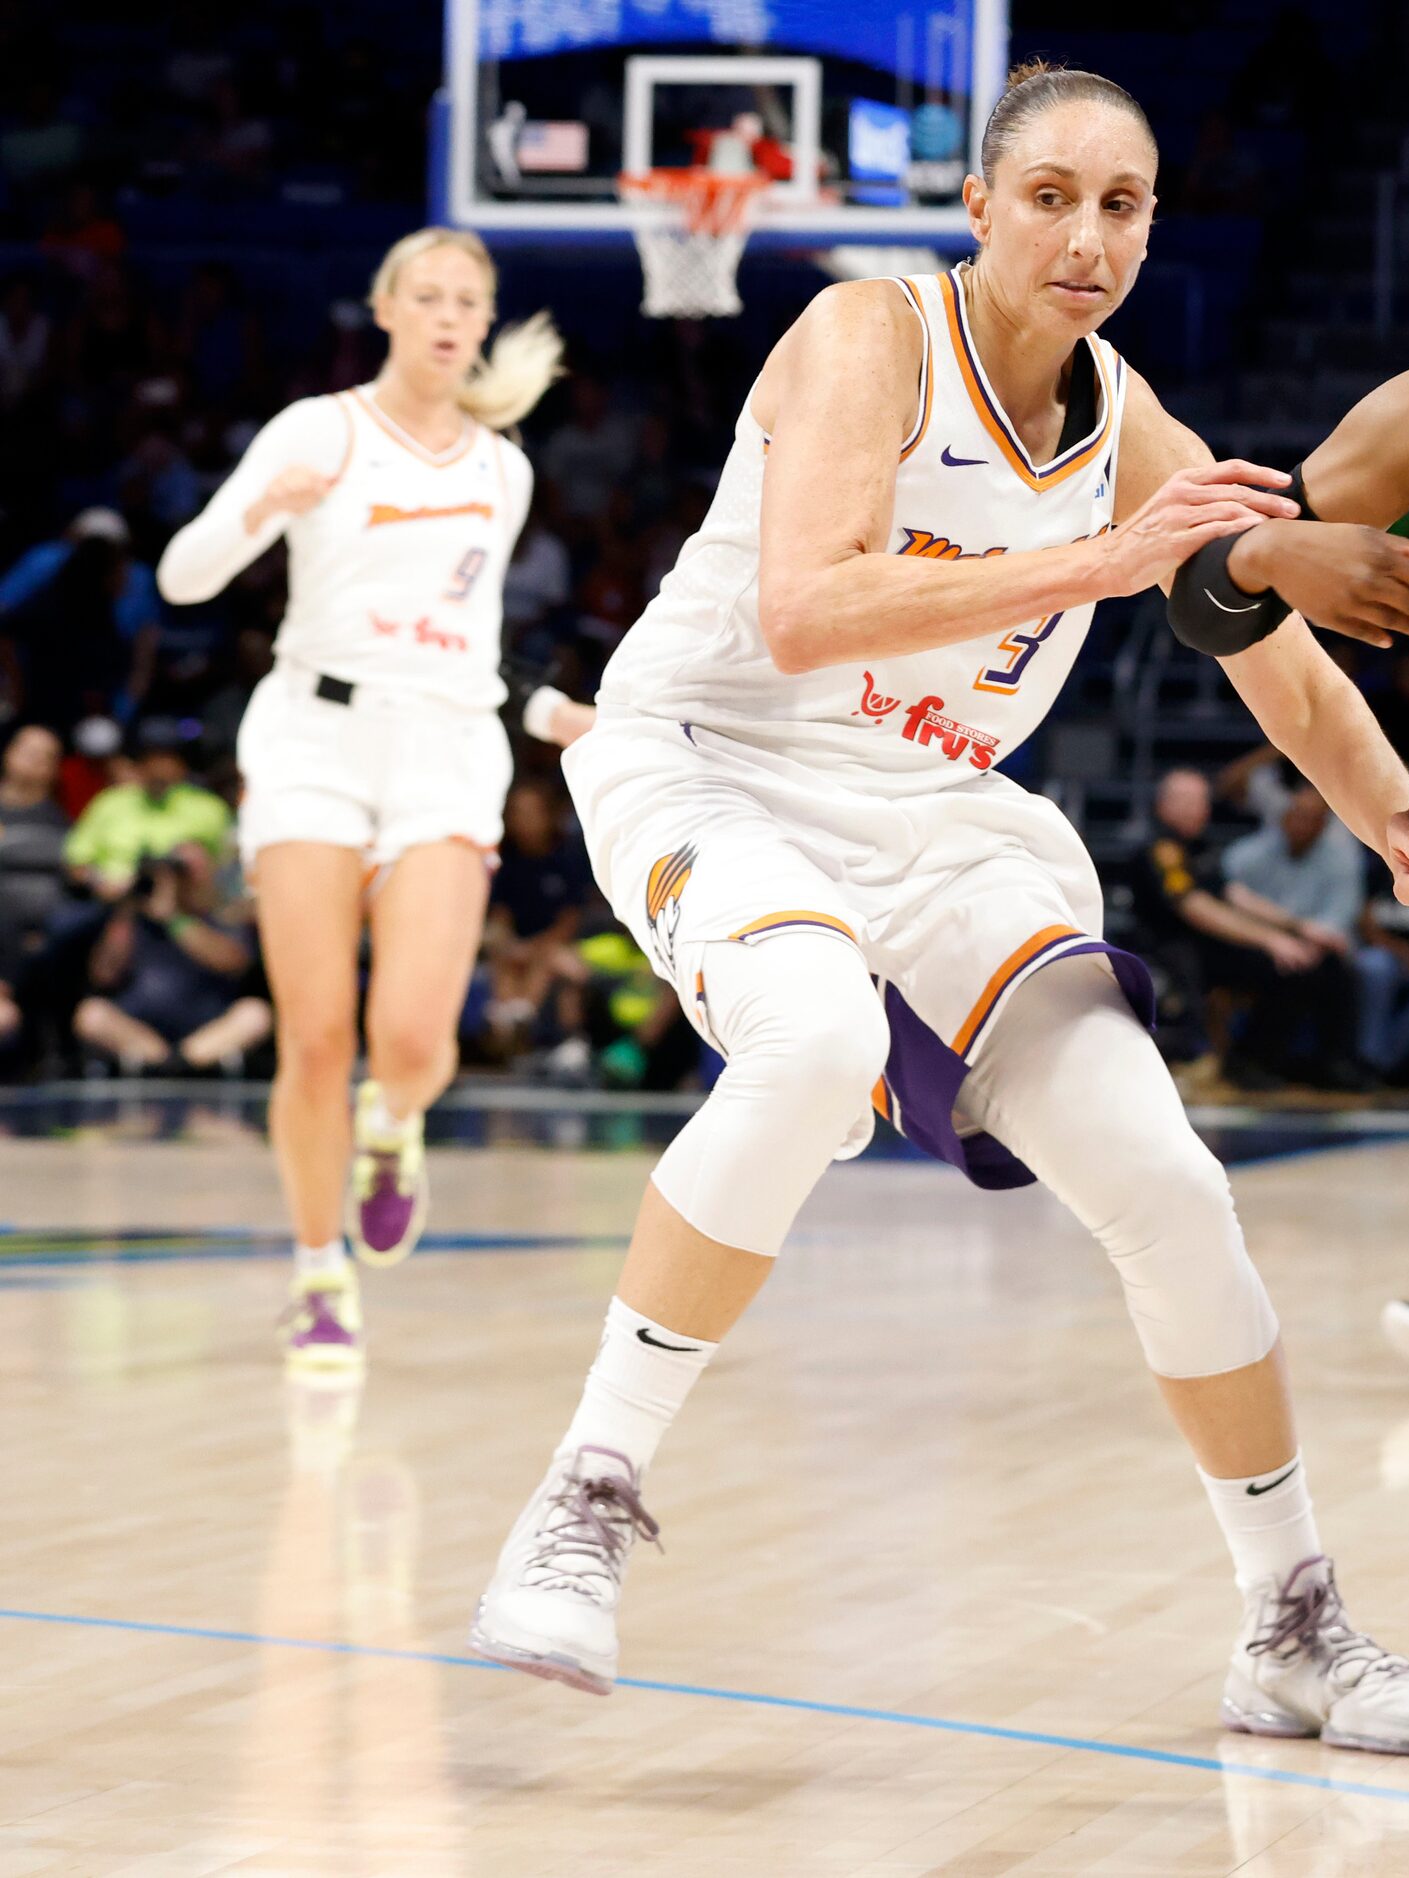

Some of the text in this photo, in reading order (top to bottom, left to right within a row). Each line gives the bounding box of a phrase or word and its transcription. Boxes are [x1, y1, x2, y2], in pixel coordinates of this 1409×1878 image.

[972, 611, 1064, 695] 3
[901, 695, 997, 770] fry's
[925, 711, 997, 746] FOOD STORES
